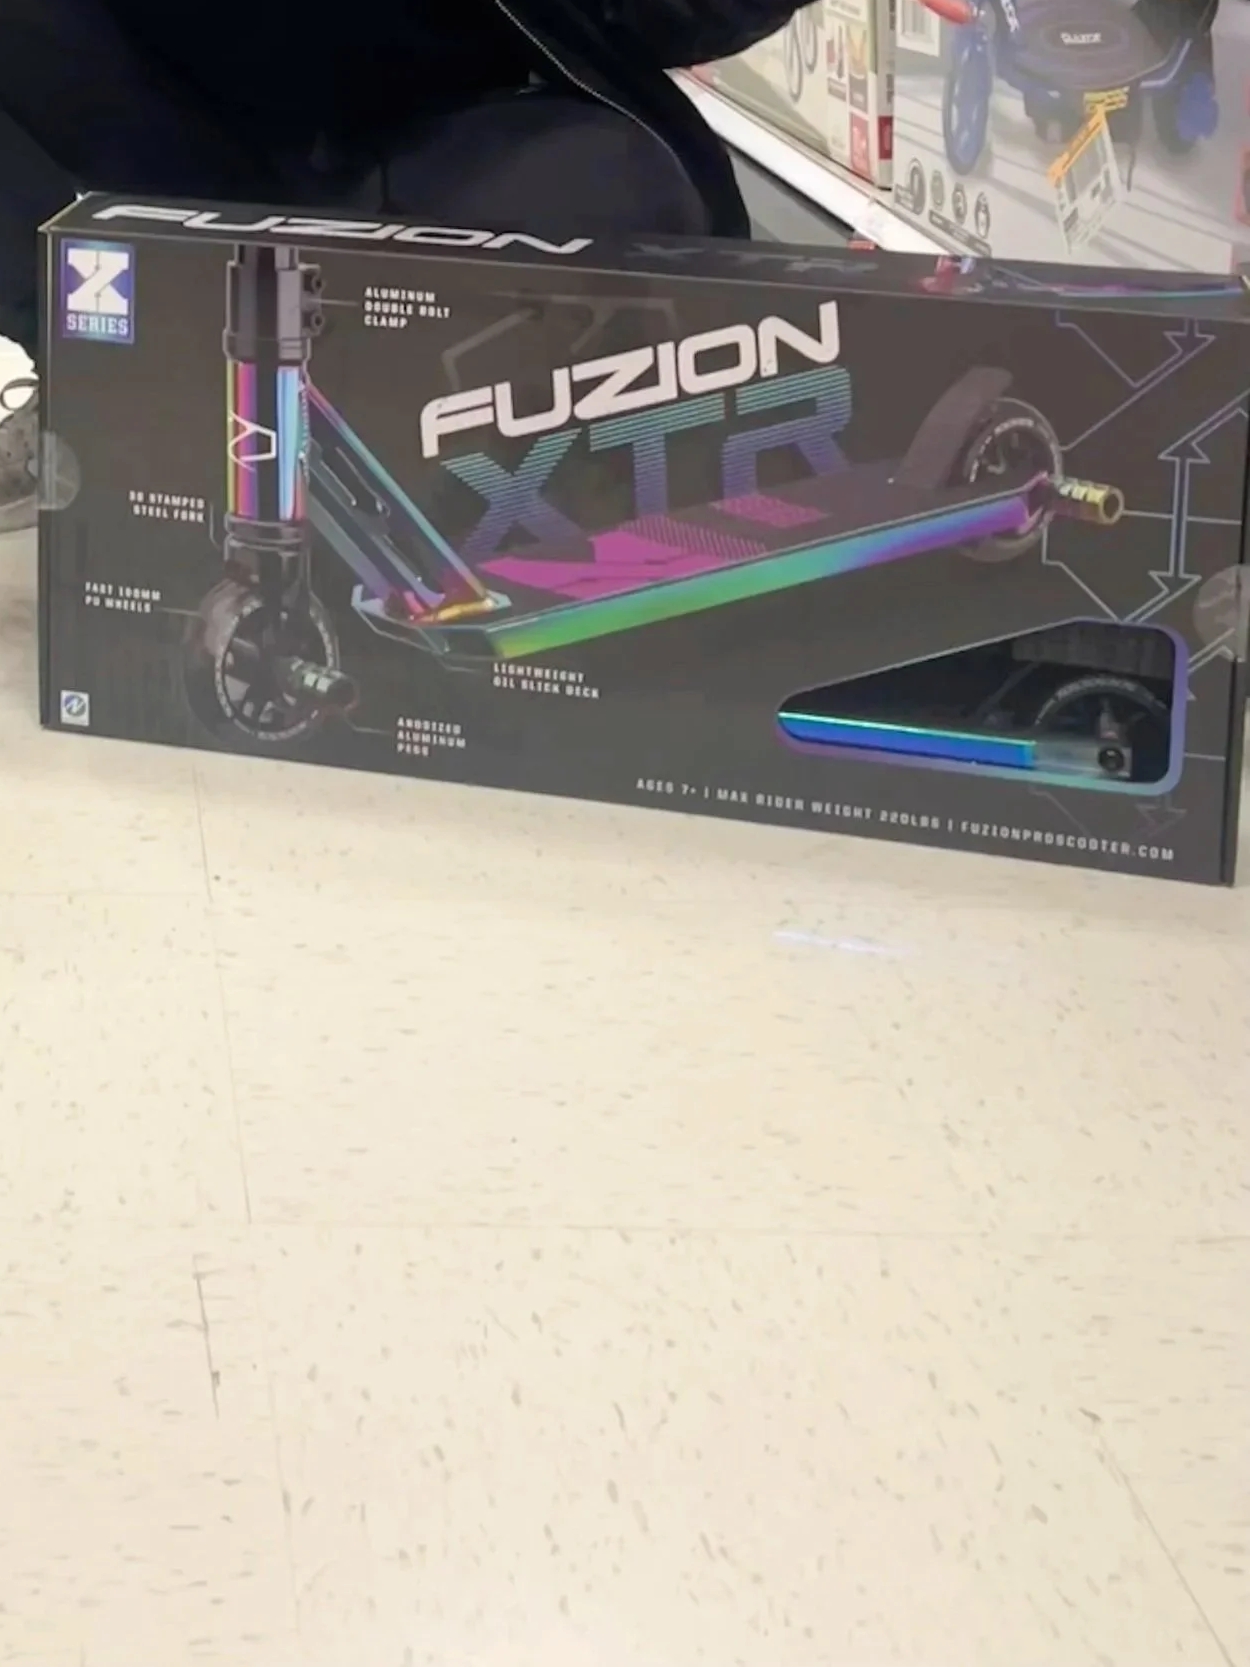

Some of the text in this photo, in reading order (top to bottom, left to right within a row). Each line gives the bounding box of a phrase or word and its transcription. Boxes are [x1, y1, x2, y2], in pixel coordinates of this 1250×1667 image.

[93, 203, 594, 255] FUZION
[364, 285, 436, 303] ALUMINUM
[364, 300, 450, 319] DOUBLE BOLT
[66, 311, 129, 336] SERIES
[364, 314, 408, 328] CLAMP
[421, 300, 841, 460] FUZION
[440, 363, 852, 560] XTR
[148, 492, 206, 510] STAMPED
[132, 504, 205, 523] STEEL FORK
[85, 581, 161, 602] FAST 100MM
[85, 595, 151, 614] PU WHEELS
[493, 662, 585, 684] LIGHTWEIGHT
[492, 675, 600, 699] OIL SLICK DECK
[397, 716, 462, 735] ANODIZED
[397, 729, 467, 749] ALUMINUM
[397, 742, 430, 757] PEGS
[636, 778, 674, 794] AGES
[717, 788, 748, 804] MAX
[755, 792, 804, 812] RIDER
[811, 801, 873, 821] WEIGHT
[879, 810, 940, 830] 220LBS
[961, 819, 1175, 862] FUZIONPROSCOOTER.COM
